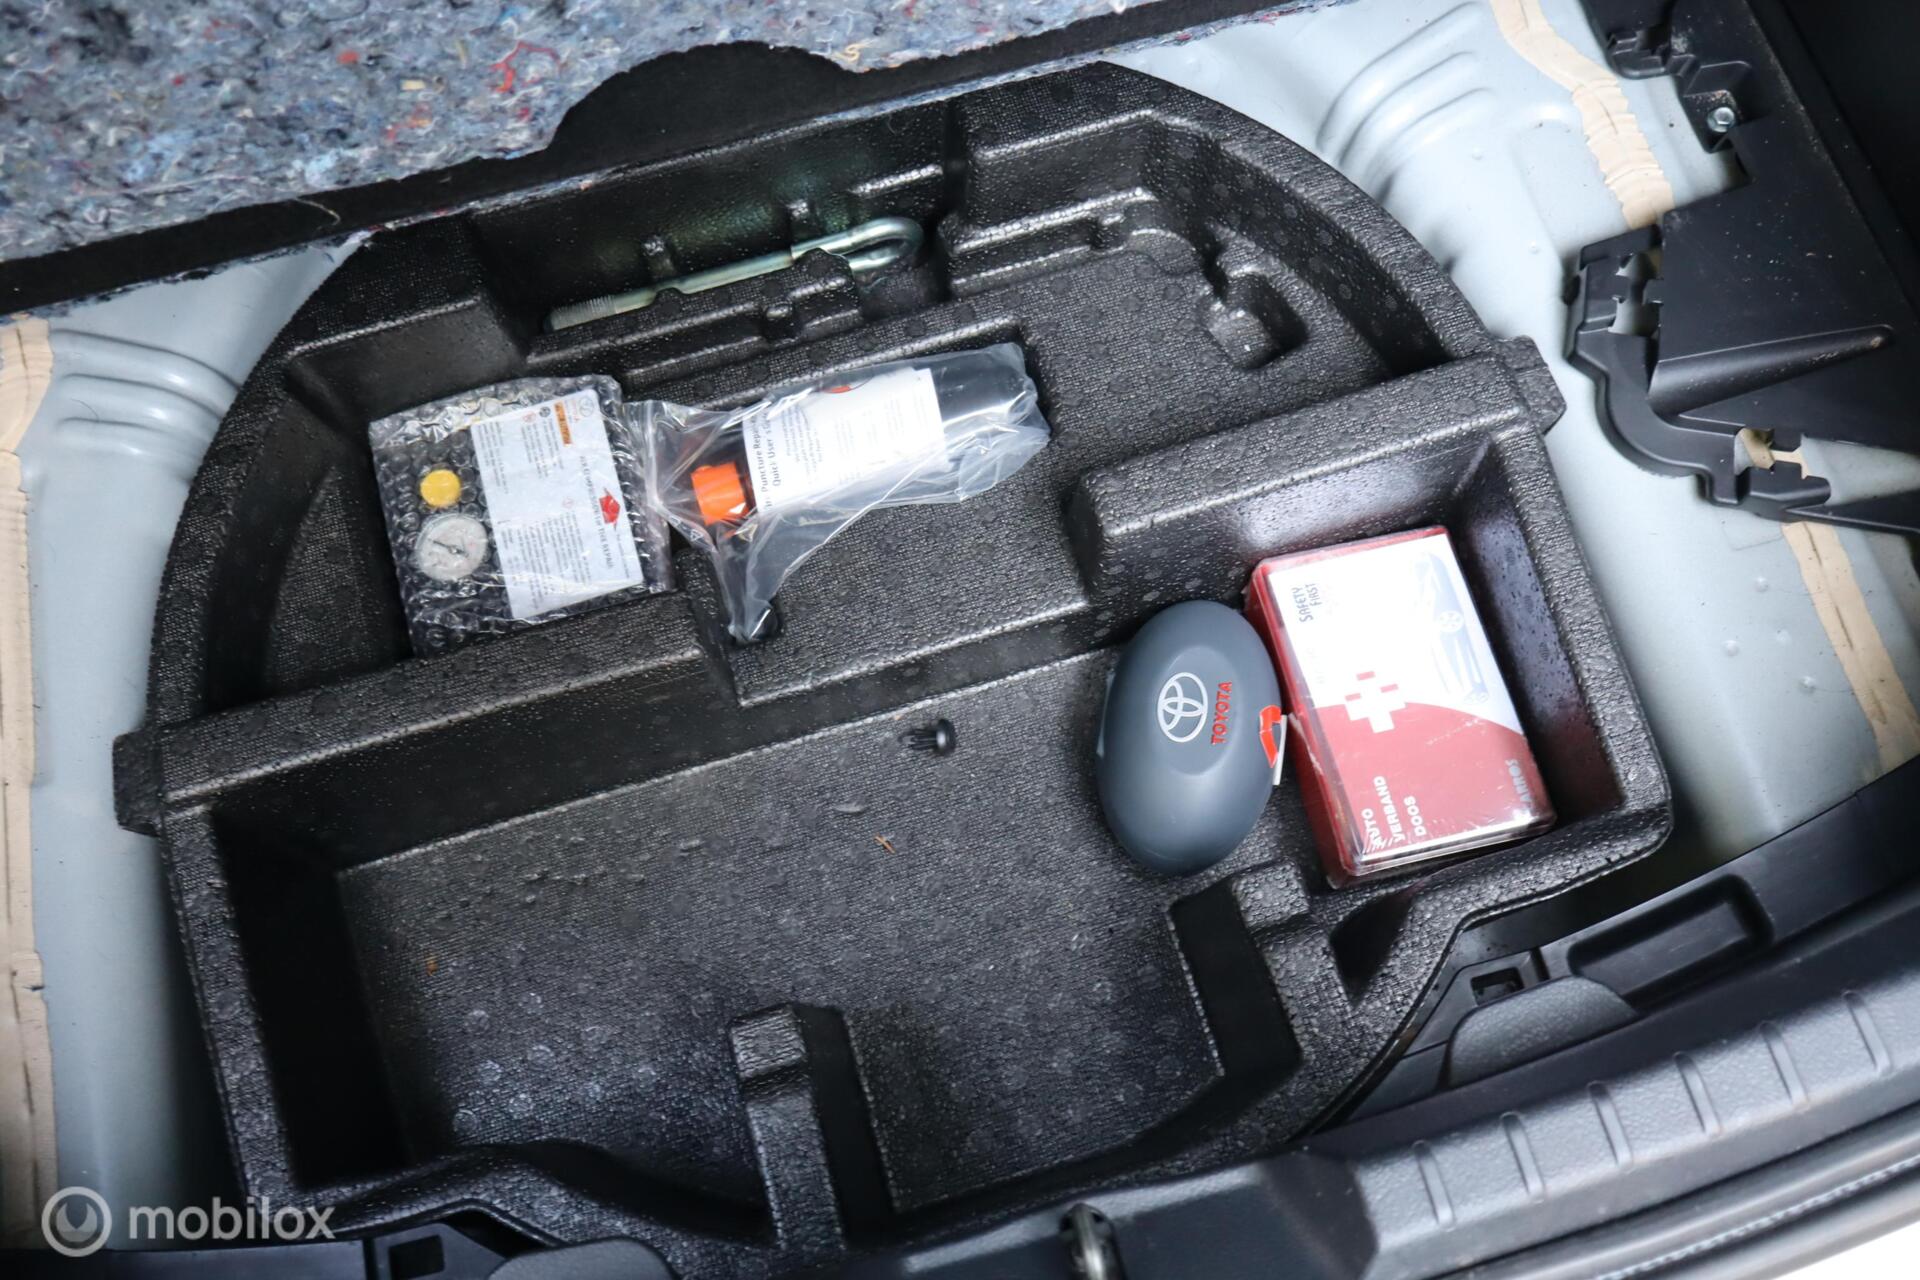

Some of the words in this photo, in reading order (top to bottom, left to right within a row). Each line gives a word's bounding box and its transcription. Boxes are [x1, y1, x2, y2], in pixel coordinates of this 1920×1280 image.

[756, 451, 769, 492] Puncture
[1292, 587, 1314, 622] SAFETY
[1305, 584, 1322, 607] FIRST
[1211, 681, 1232, 745] TOYOTA
[1361, 808, 1385, 849] AUTO
[1374, 776, 1405, 842] VERBAND
[1404, 796, 1426, 836] DOOS
